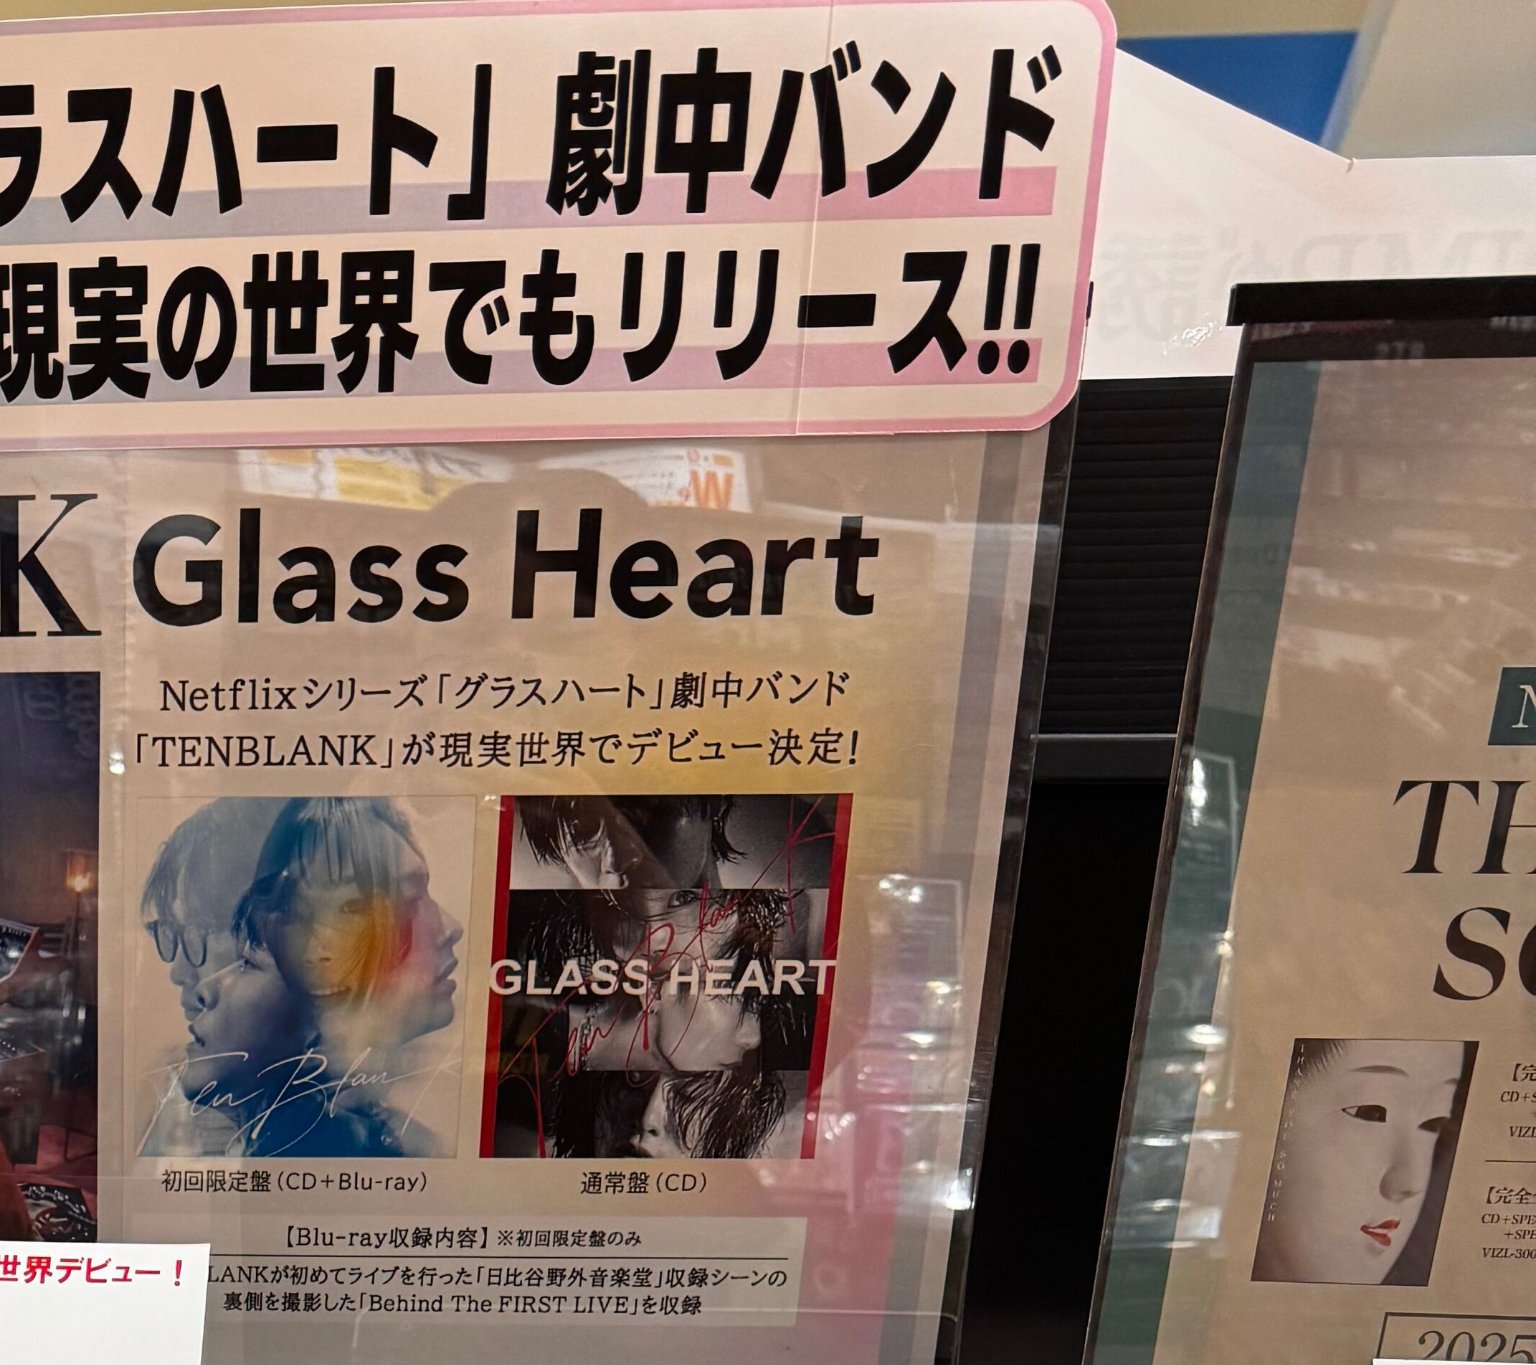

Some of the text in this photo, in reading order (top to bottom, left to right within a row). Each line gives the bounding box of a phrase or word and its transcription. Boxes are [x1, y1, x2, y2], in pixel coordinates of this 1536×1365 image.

[133, 509, 878, 624] Glass Heart
[160, 671, 851, 713] Netflixシリーズ「グラスハート」劇中バンド
[136, 727, 860, 770] 「TENBLANK」が現実世界でデビュー決定!
[490, 959, 837, 997] GLASS HEART
[162, 1170, 428, 1195] 初回限定盤(CD+Blu-ray)
[581, 1171, 707, 1195] 通常盤(CD)
[224, 1292, 702, 1318] 裏側を撮影した「Behind The FIRST LIVE」を収録
